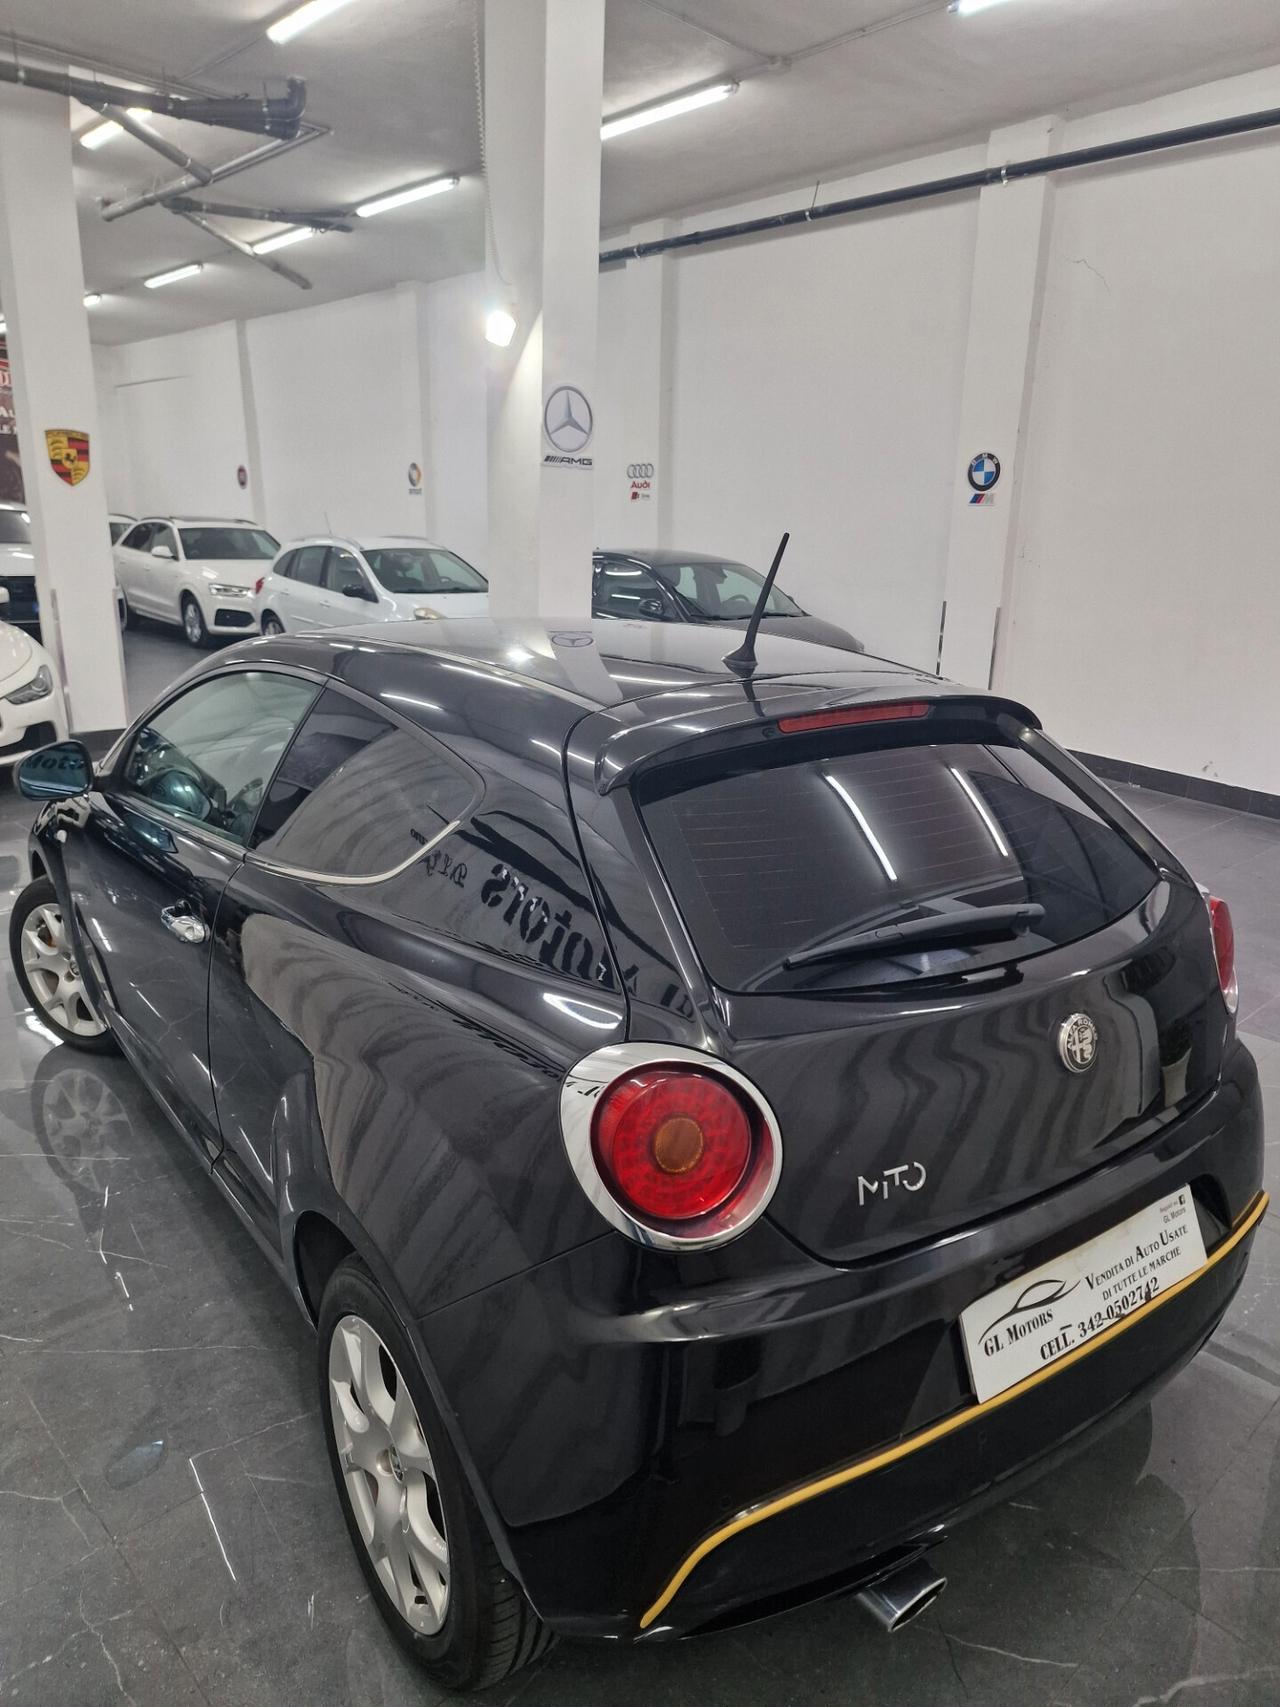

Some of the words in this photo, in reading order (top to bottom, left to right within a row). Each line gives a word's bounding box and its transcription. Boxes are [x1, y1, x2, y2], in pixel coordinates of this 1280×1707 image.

[630, 481, 651, 489] Audi
[1102, 1288, 1112, 1301] DI
[1113, 1272, 1138, 1293] TUTTE
[1138, 1265, 1149, 1279] LE
[1149, 1246, 1181, 1272] MARCHE
[984, 1334, 1004, 1357] GL
